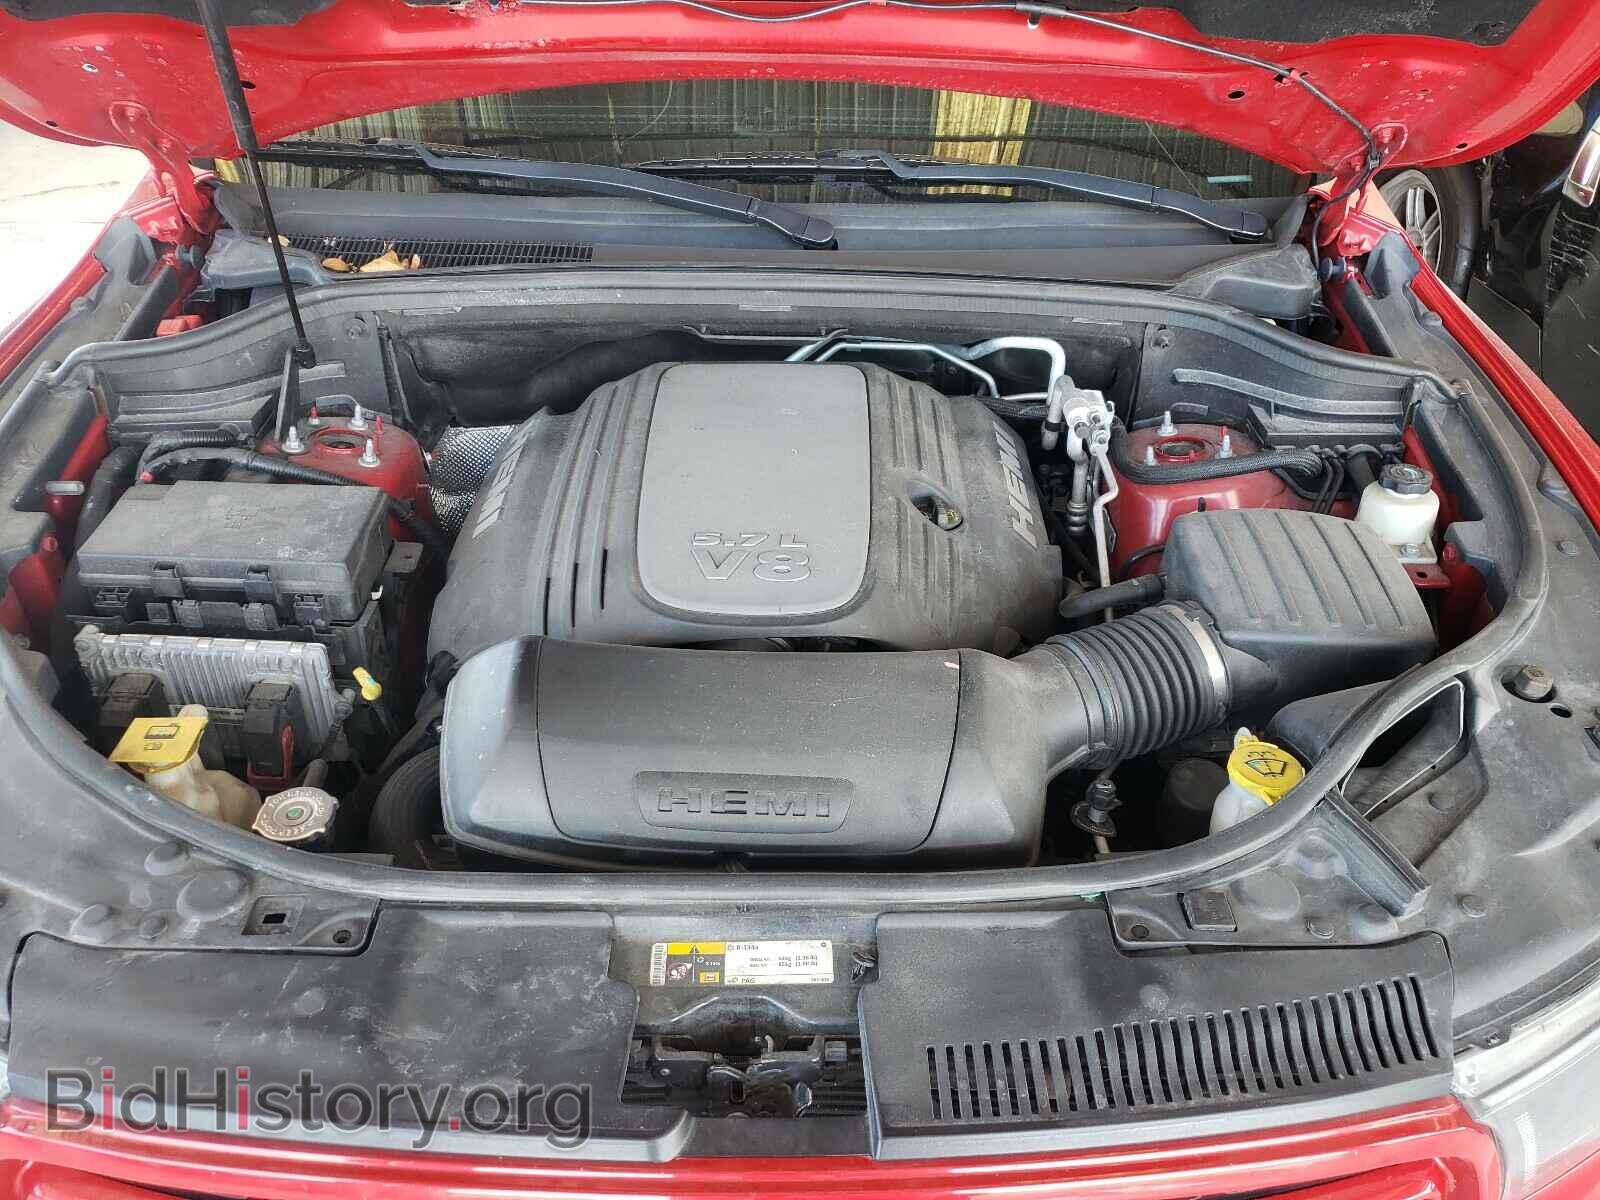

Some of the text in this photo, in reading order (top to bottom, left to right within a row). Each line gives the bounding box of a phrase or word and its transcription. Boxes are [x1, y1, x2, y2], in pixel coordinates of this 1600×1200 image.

[992, 420, 1038, 549] HEMI
[692, 531, 808, 548] 5.7L
[690, 549, 811, 582] V8
[657, 786, 830, 817] HEMI
